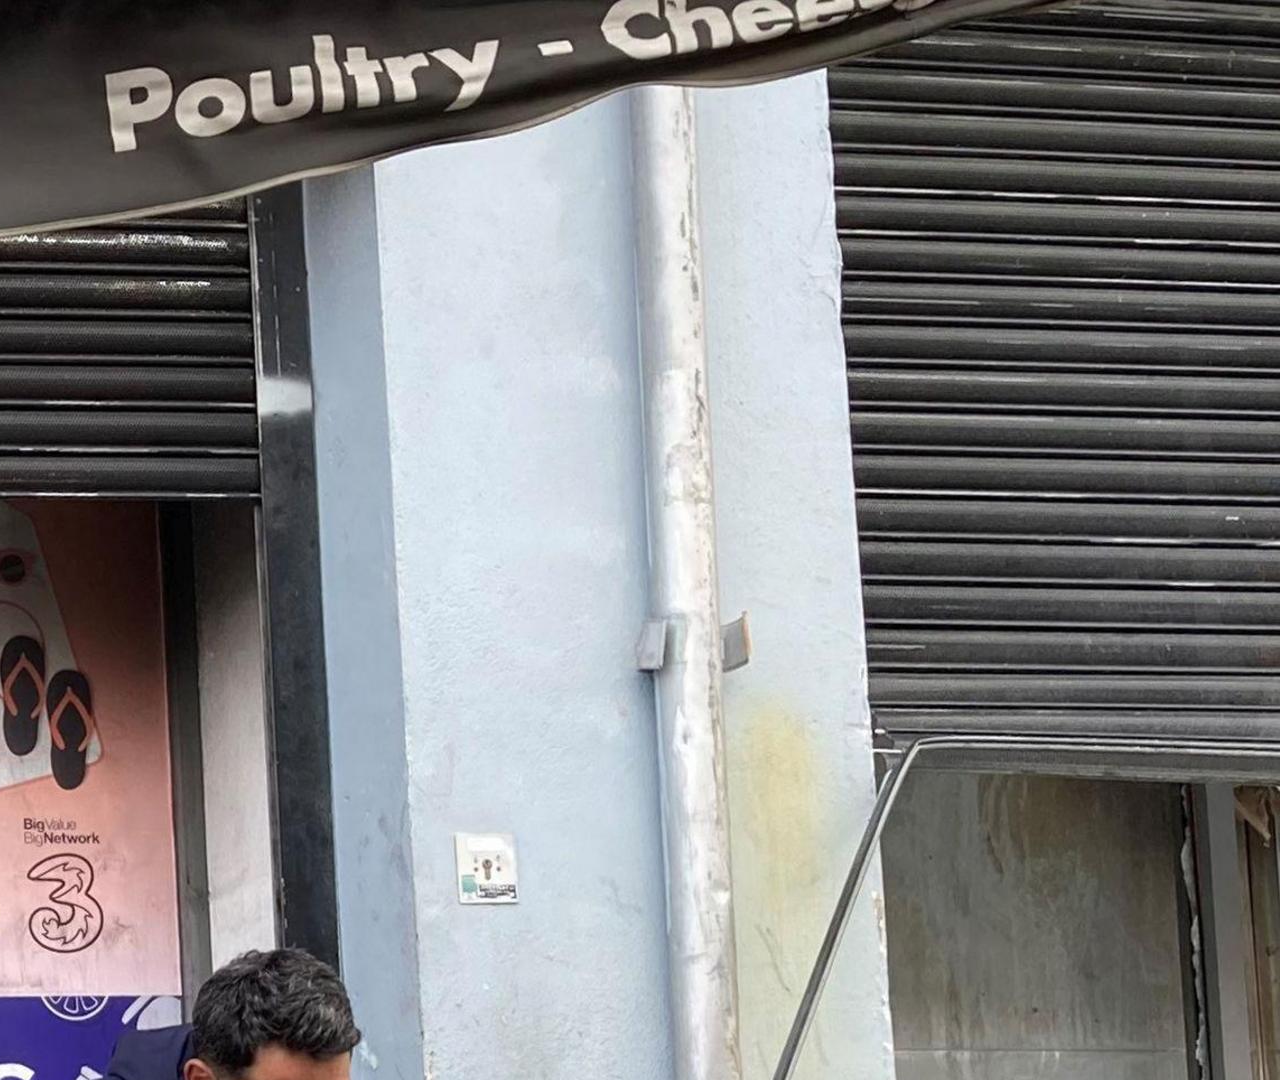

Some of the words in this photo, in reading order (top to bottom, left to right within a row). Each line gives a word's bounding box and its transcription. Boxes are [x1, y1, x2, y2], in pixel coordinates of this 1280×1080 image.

[104, 34, 500, 154] Poultry
[600, 0, 939, 61] Chee
[23, 832, 101, 847] BigNetwork
